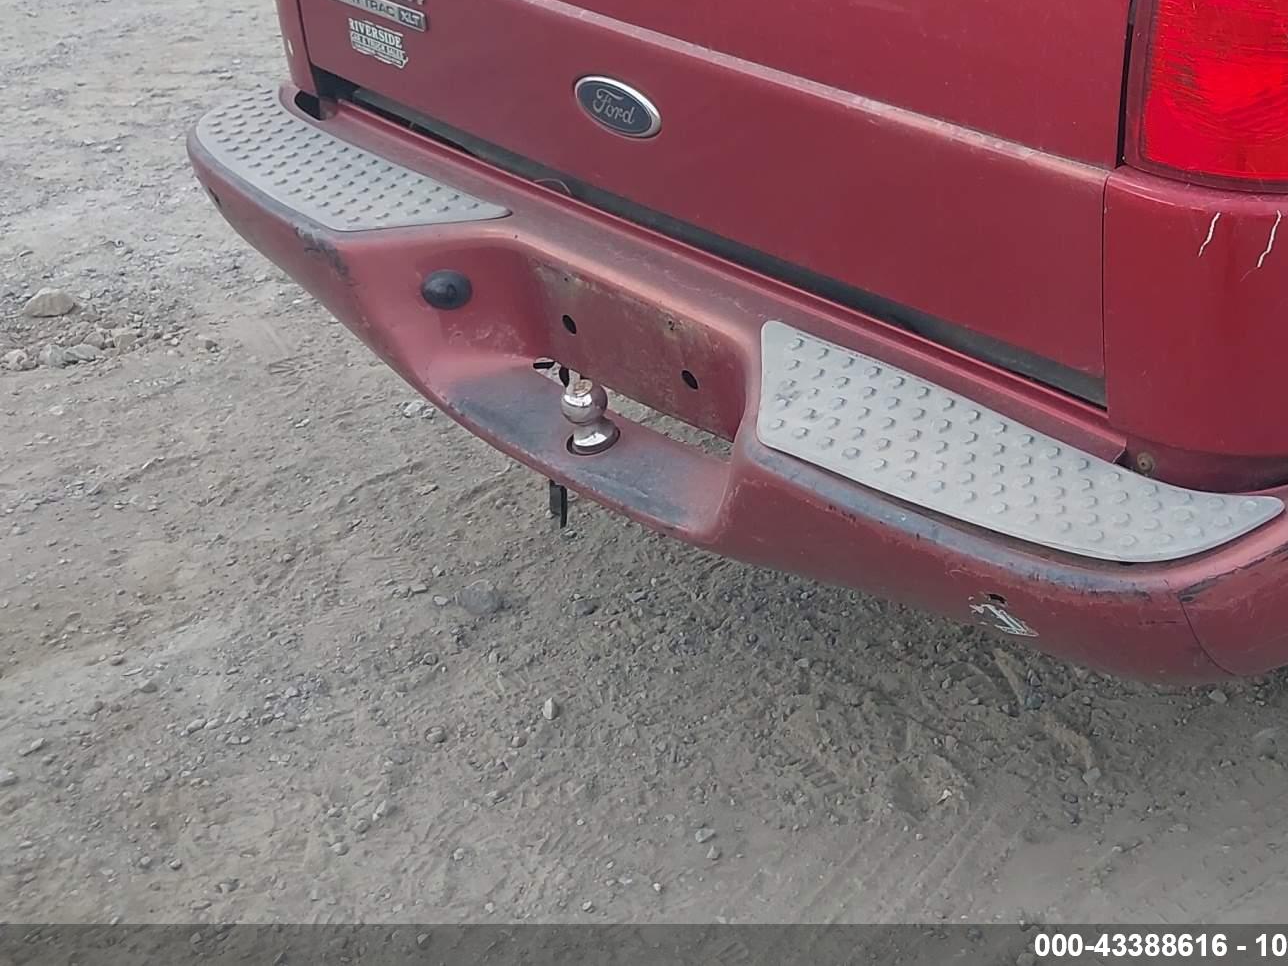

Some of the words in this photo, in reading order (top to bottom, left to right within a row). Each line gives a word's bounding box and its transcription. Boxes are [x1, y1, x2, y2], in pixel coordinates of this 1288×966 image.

[399, 8, 421, 27] XLT
[348, 18, 404, 49] RIVERSIDE
[592, 88, 637, 125] Ford
